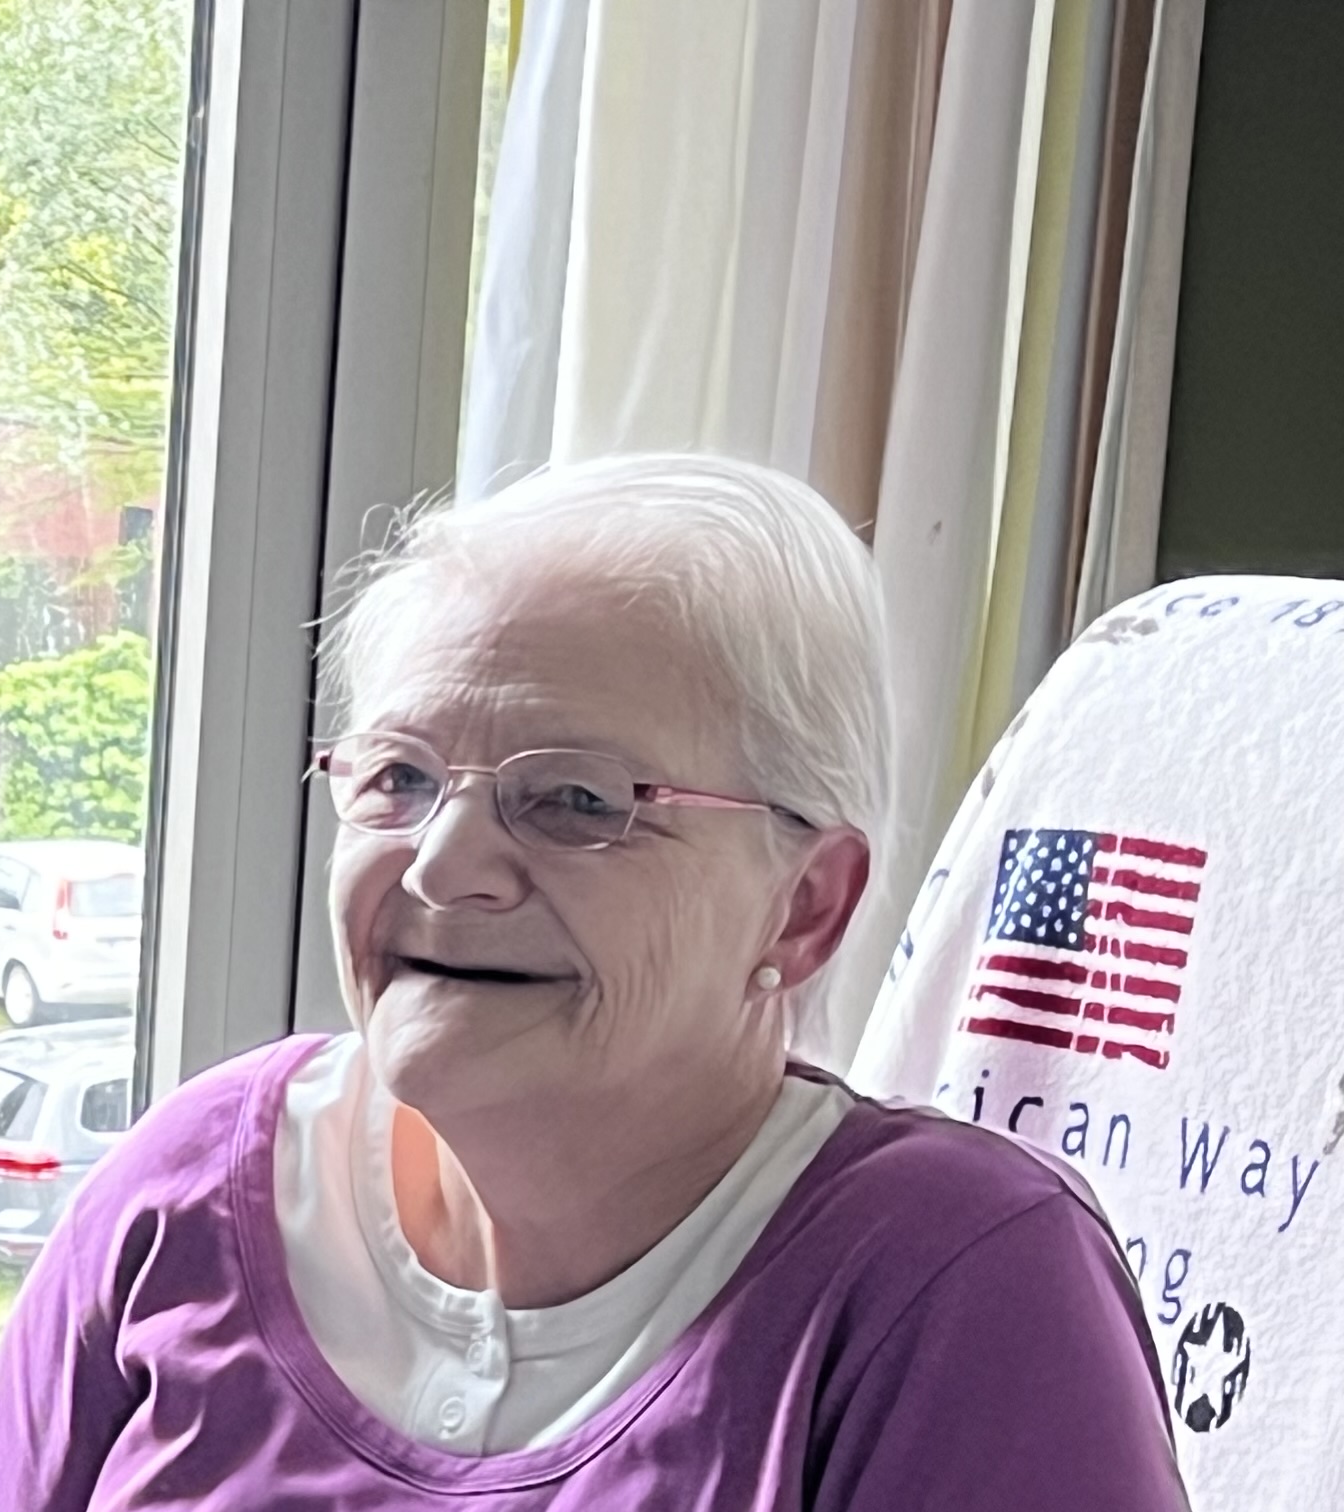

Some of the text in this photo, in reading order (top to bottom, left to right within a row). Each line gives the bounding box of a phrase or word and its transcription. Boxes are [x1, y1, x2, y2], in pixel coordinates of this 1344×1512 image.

[936, 1070, 1320, 1232] ican Way
[1123, 1236, 1193, 1325] ng
